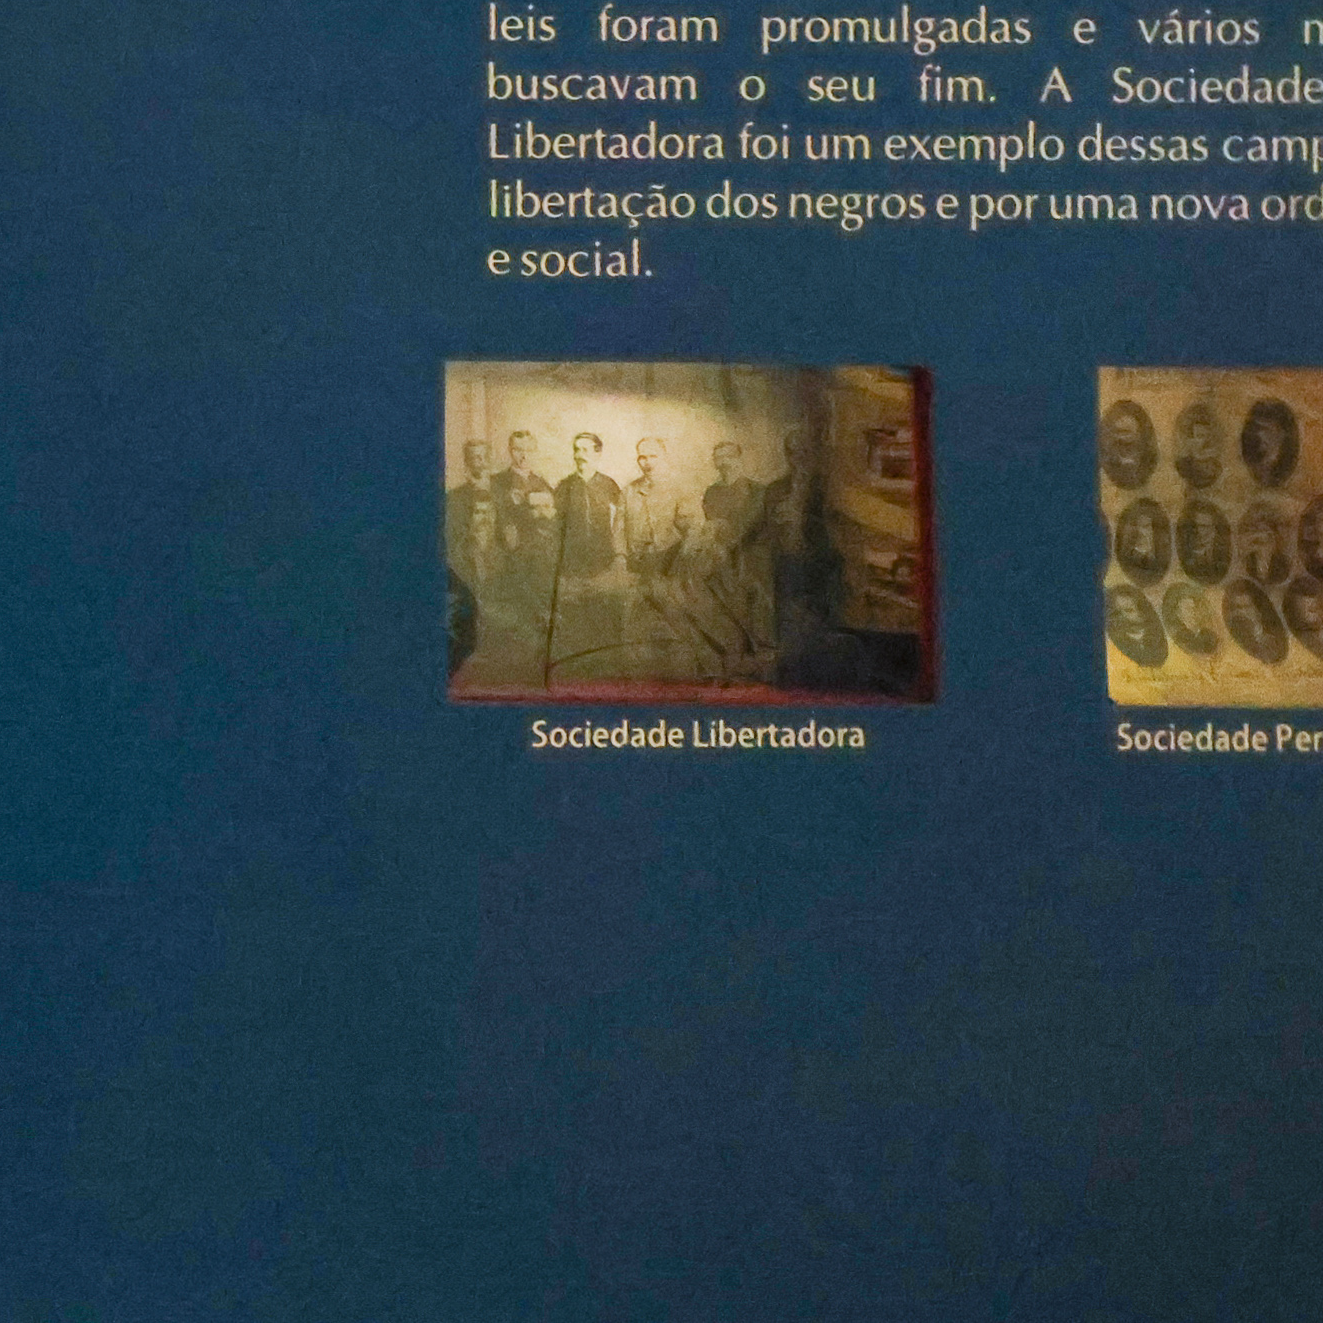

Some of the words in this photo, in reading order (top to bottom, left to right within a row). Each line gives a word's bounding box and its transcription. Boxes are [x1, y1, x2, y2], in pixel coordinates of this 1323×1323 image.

[488, 1, 557, 42] leis
[598, 2, 719, 42] foram
[761, 4, 1033, 56] promulgadas
[1072, 18, 1097, 45] e
[1137, 9, 1260, 45] vários
[486, 61, 698, 101] buscavam
[738, 75, 766, 102] o
[807, 75, 876, 103] seu
[918, 63, 996, 102] fim.
[1039, 66, 1073, 103] A
[1112, 65, 1323, 104] Sociedade
[488, 120, 724, 160] Libertadora
[738, 121, 790, 160] foi
[804, 133, 872, 161] um
[883, 120, 1065, 172] exemplo
[1077, 122, 1209, 162] dessas
[489, 179, 696, 228] libertação
[705, 180, 779, 220] dos
[788, 193, 927, 233] negros
[935, 193, 960, 220] e
[969, 193, 1039, 232] por
[1049, 193, 1139, 221] uma
[1150, 194, 1250, 221] nova
[486, 249, 512, 276] e
[520, 238, 653, 278] social.
[530, 720, 685, 750] Sociedade
[692, 719, 866, 749] Libertadora
[1115, 721, 1269, 753] Sociedade
